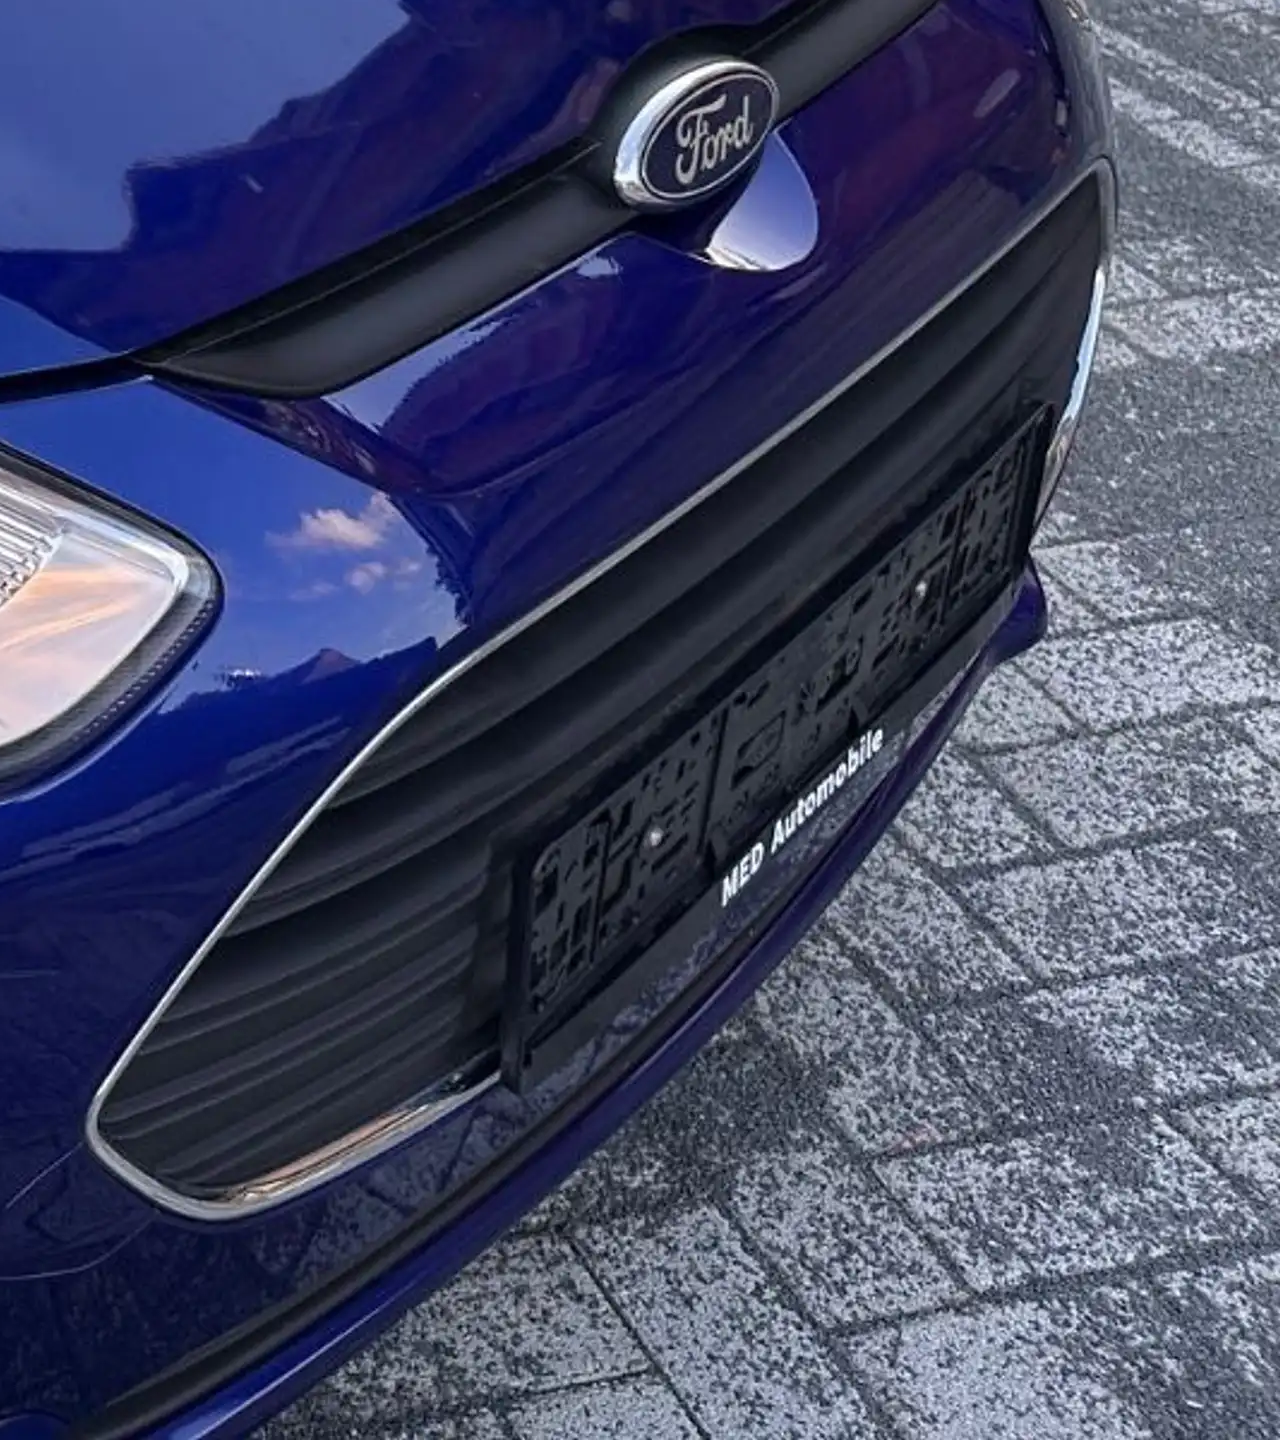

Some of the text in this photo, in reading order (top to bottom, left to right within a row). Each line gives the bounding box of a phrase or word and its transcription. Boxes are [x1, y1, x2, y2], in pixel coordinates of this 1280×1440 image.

[675, 94, 753, 184] Ford
[721, 728, 883, 907] MED Automobile
